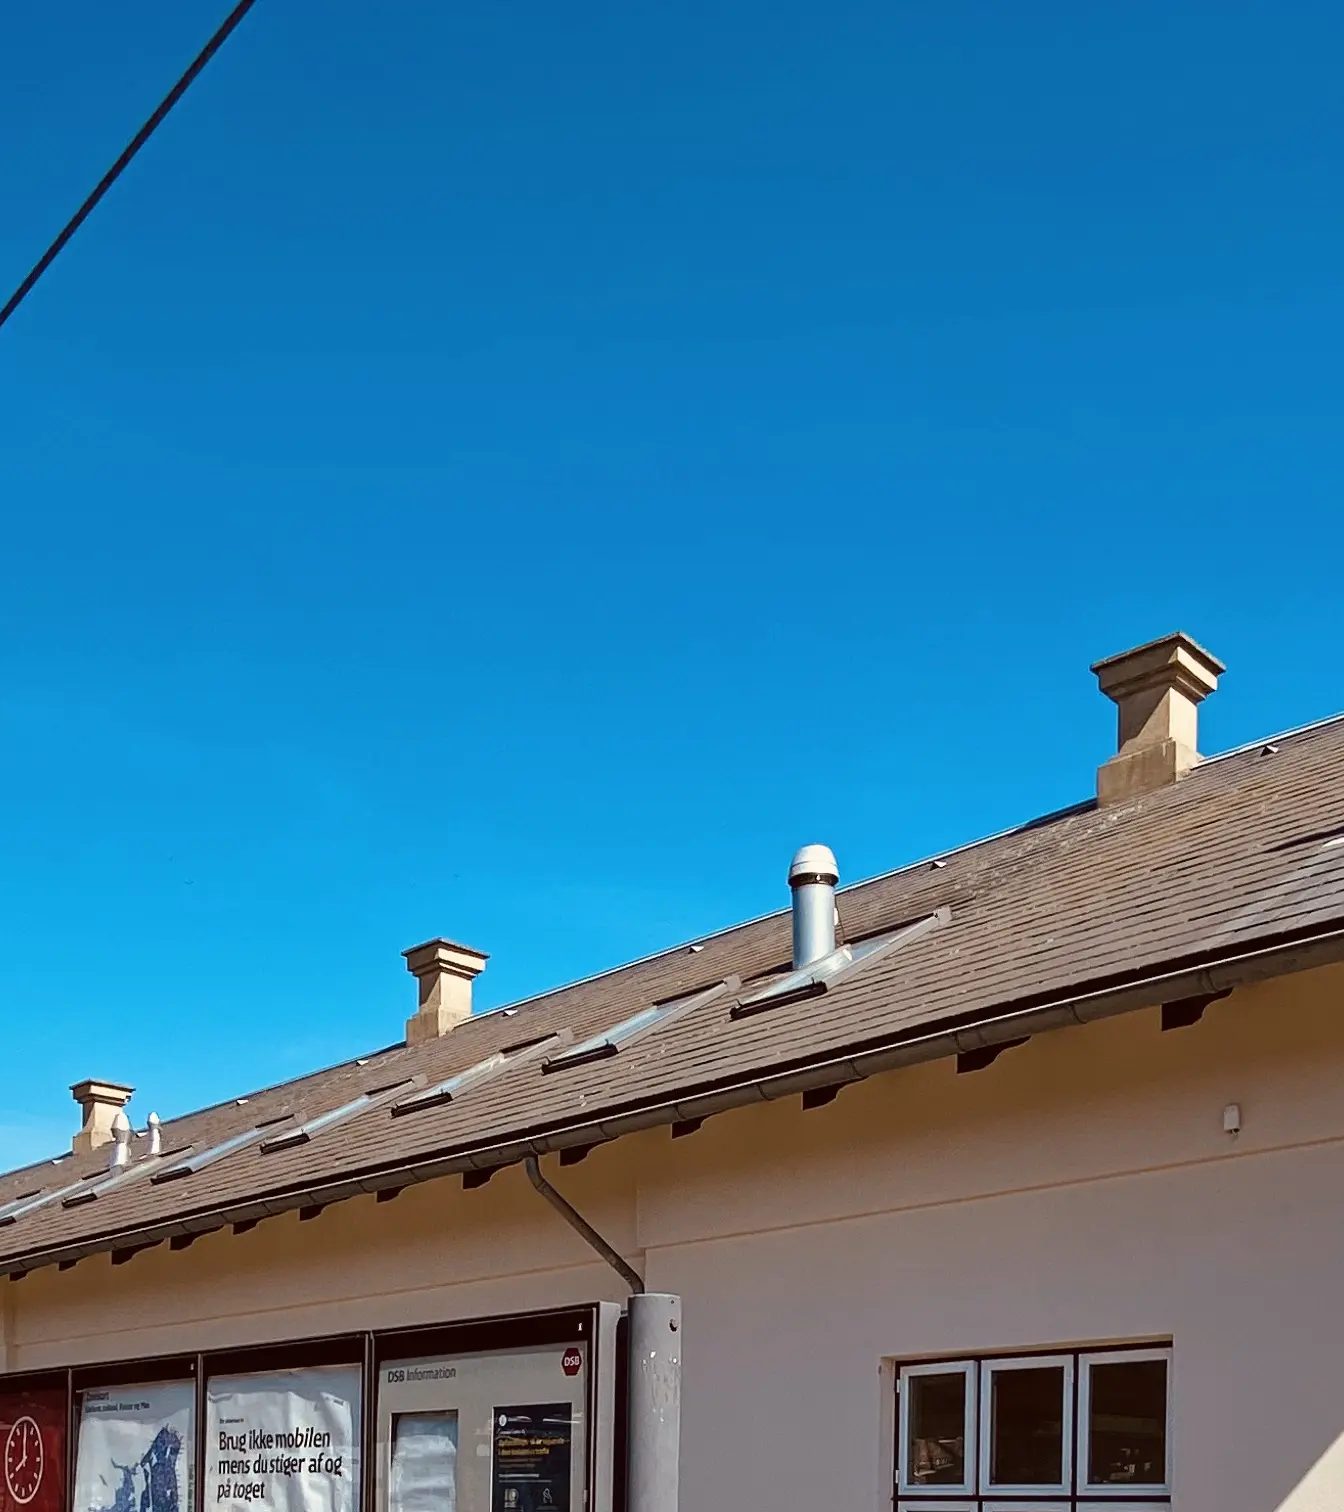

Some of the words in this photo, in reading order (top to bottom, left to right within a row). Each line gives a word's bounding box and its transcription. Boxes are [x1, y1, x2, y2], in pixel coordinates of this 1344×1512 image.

[564, 1355, 580, 1367] DSB
[387, 1369, 405, 1383] DSB
[406, 1366, 456, 1381] Information
[219, 1430, 247, 1454] Brug
[248, 1429, 273, 1449] ikke
[275, 1427, 330, 1449] mobilen
[218, 1459, 251, 1474] mens
[253, 1454, 268, 1474] du
[268, 1454, 305, 1477] stiger
[308, 1452, 325, 1473] af
[324, 1456, 343, 1477] og
[217, 1478, 231, 1503] på
[233, 1481, 265, 1502] toget
